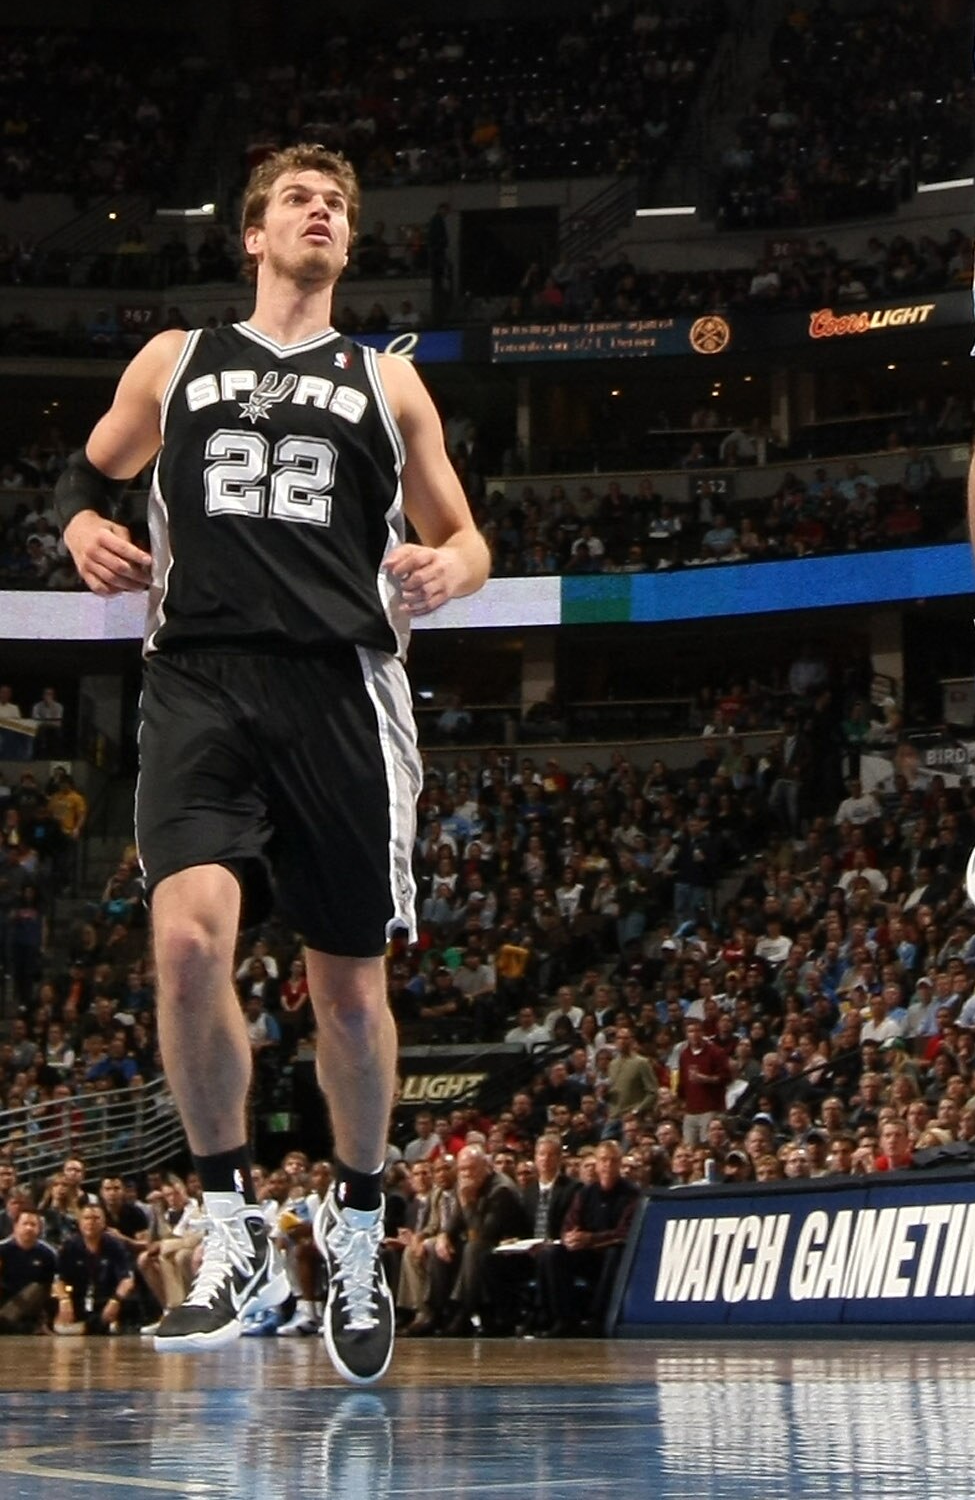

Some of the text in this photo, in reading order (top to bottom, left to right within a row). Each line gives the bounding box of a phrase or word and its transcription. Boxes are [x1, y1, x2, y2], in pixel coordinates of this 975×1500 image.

[808, 304, 936, 339] Coors LIGHT
[186, 370, 368, 424] SPURS
[204, 429, 338, 527] 22
[402, 1073, 488, 1100] LIGHT
[654, 1213, 790, 1304] WATCH
